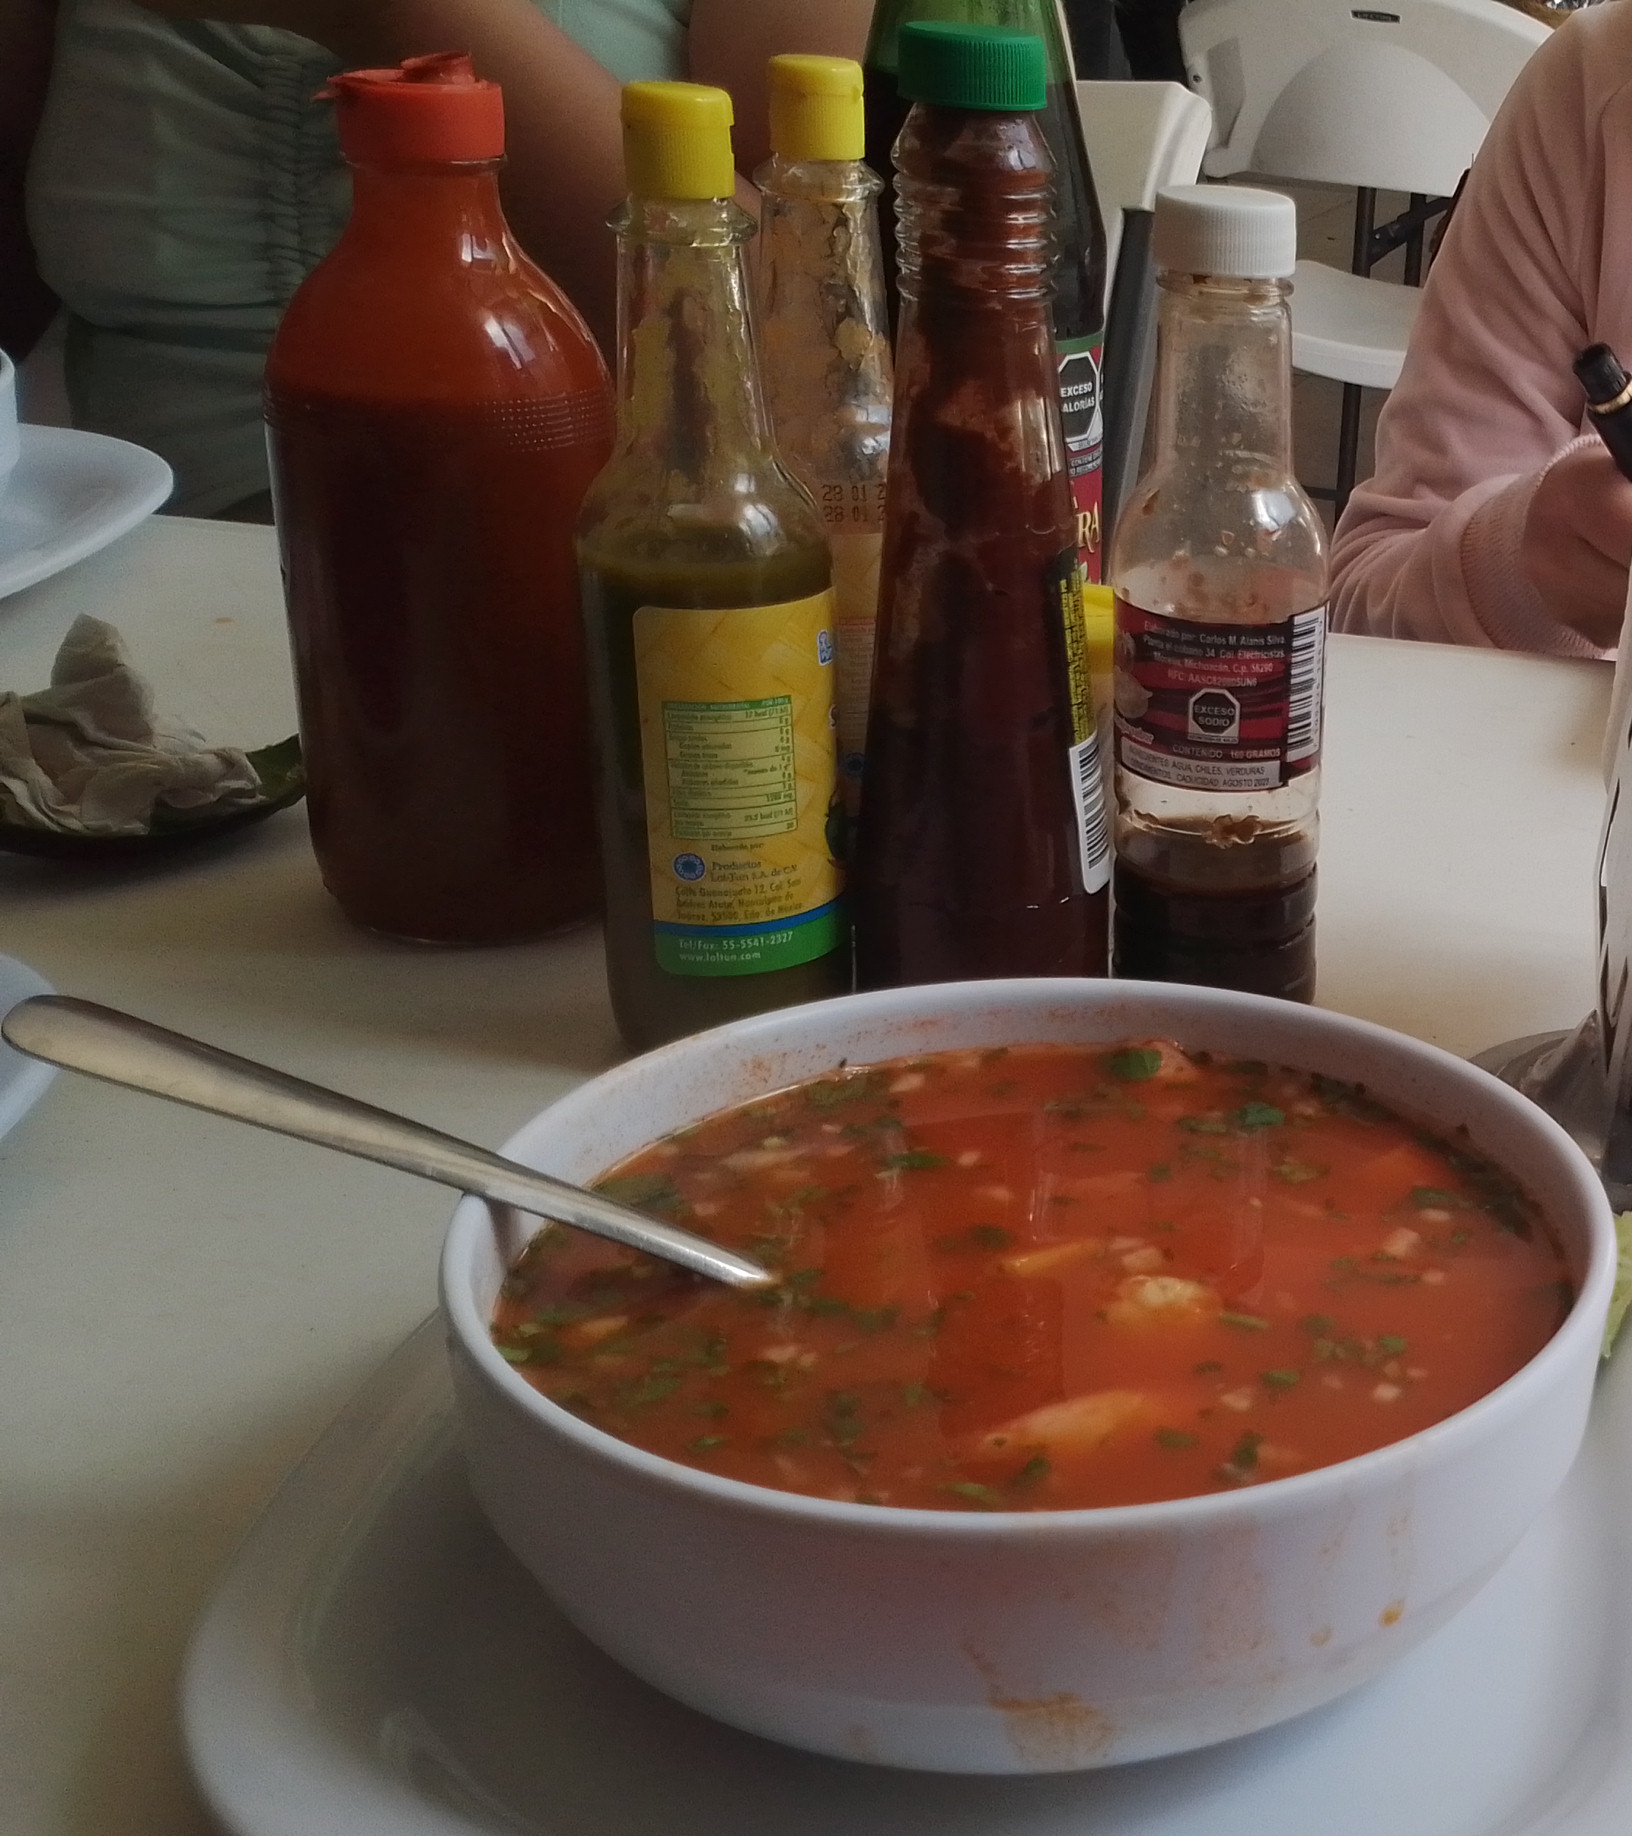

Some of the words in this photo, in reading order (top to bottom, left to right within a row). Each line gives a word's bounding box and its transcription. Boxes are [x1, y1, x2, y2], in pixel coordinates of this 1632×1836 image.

[1060, 381, 1093, 397] EXCESO
[1061, 396, 1095, 413] ALORÍAS
[1076, 501, 1100, 554] RA
[1199, 633, 1227, 645] Carlos
[1194, 704, 1235, 716] EXCESO
[1198, 716, 1230, 727] SODIO
[1172, 744, 1223, 759] CONTENIDO
[1245, 747, 1281, 760] GRAMOS
[1226, 766, 1265, 776] VERDURAS
[1222, 778, 1253, 788] AGOSTO
[711, 861, 762, 871] Productos
[722, 930, 794, 950] 55-5541-2327
[679, 951, 762, 963] www.loltun.com
